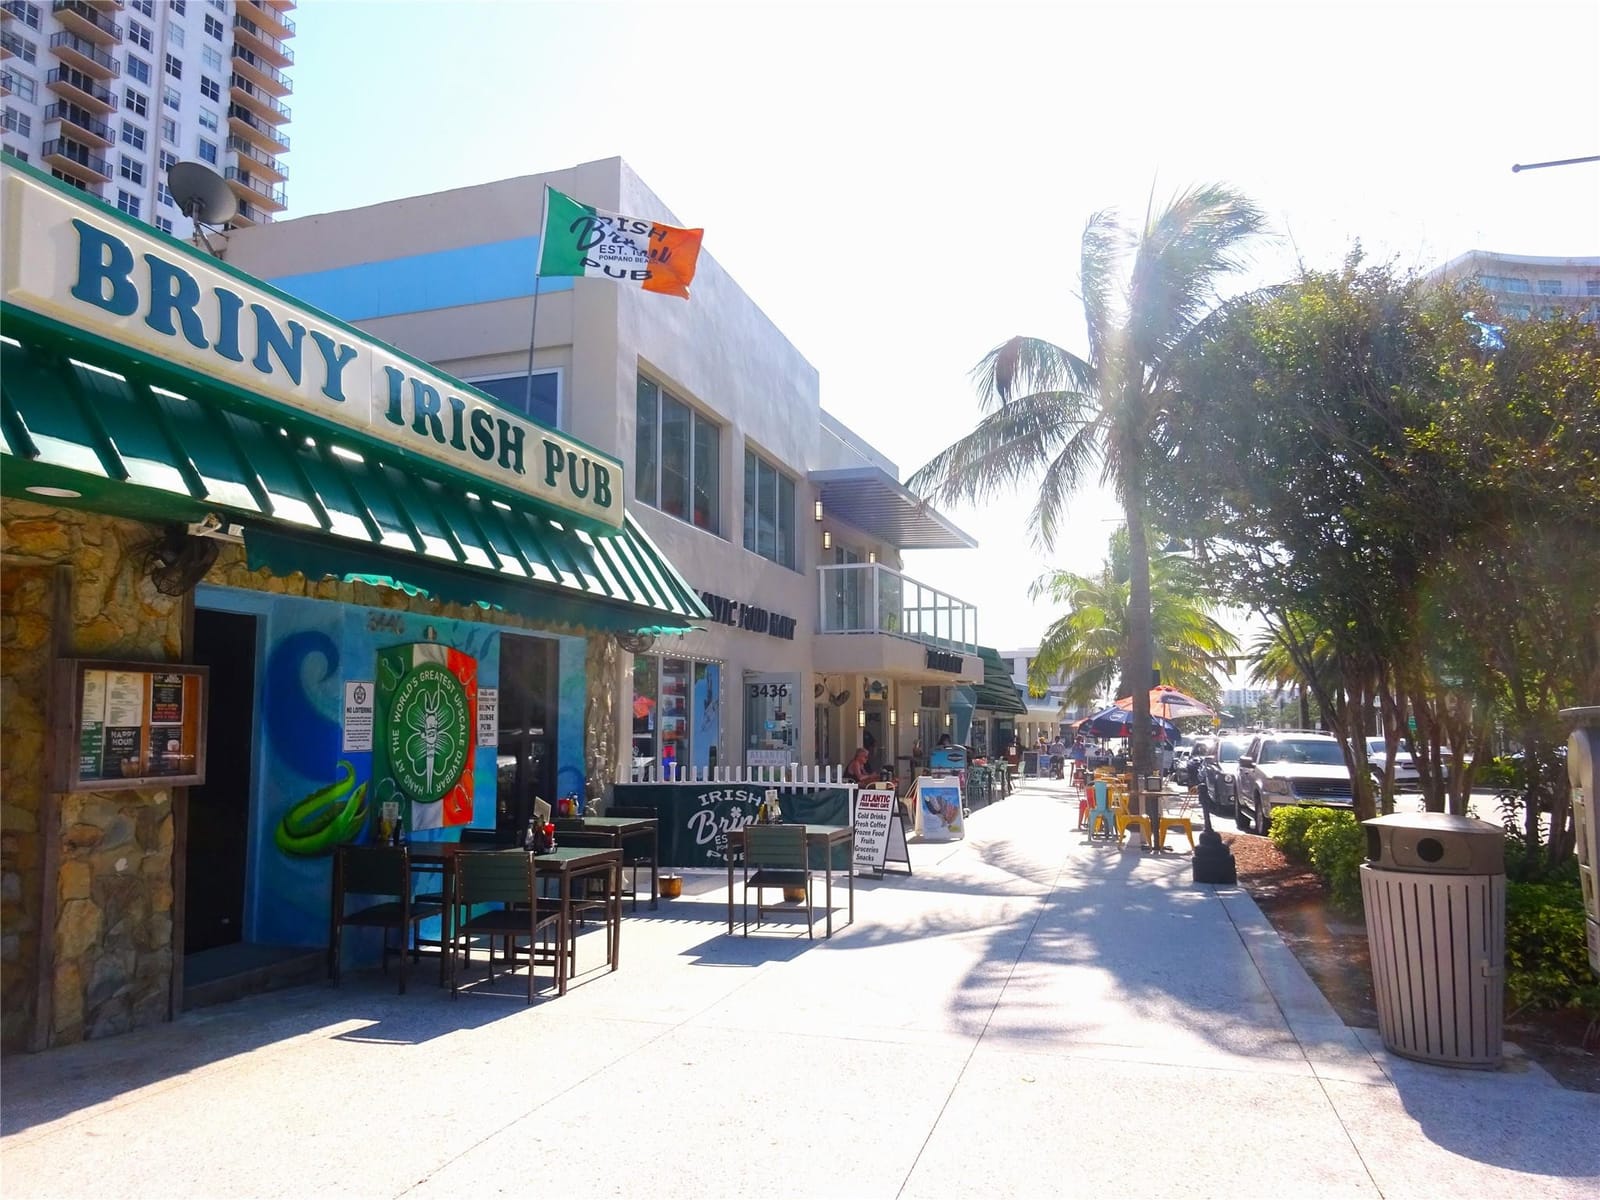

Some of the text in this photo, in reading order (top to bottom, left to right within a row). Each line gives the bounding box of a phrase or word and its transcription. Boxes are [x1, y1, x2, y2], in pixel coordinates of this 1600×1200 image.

[599, 244, 628, 255] EST.
[598, 254, 633, 263] POMPANO
[580, 257, 653, 280] PUB
[72, 218, 612, 508] BRINY IRISH PUB
[420, 670, 455, 693] GREATEST
[751, 684, 787, 698] 3436
[393, 677, 418, 723] WORLD'S
[454, 694, 466, 746] UPSCALE
[392, 729, 400, 754] THE
[395, 759, 405, 773] AT
[404, 774, 424, 795] HANG
[698, 789, 761, 807] IRISH
[860, 794, 891, 803] ATLANTIC
[857, 812, 869, 820] Cold
[855, 820, 887, 829] Fresh Coffee
[855, 828, 871, 836] Frozen
[854, 845, 879, 853] Groceries
